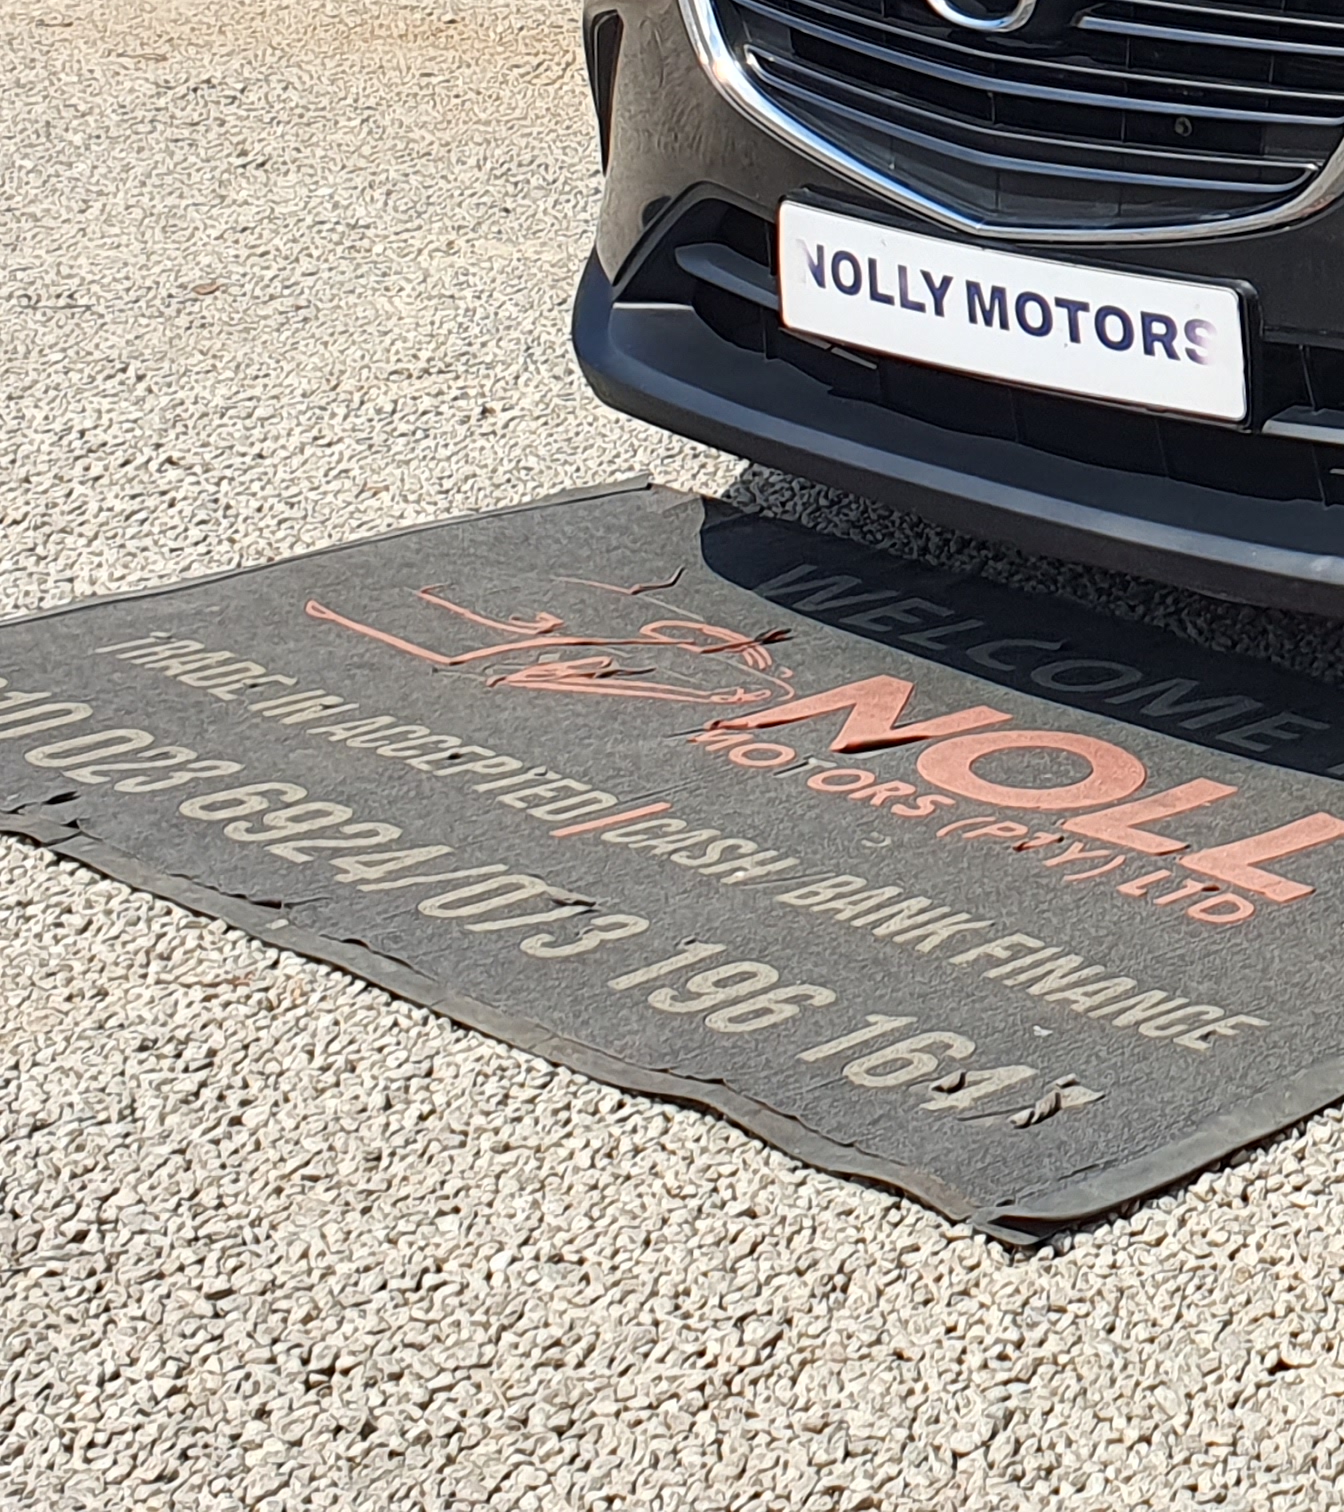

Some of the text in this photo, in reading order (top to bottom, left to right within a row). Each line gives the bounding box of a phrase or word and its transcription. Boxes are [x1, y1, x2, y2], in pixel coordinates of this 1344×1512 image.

[797, 239, 1217, 366] NOLLY MOTORS
[757, 563, 1331, 753] WELCOME
[24, 728, 246, 794] 023
[607, 938, 838, 1034] 196
[94, 631, 298, 701] TRADE
[248, 688, 359, 726] IN
[947, 932, 1271, 1052] FINANCE
[688, 727, 957, 818] MOTORS
[1116, 868, 1256, 925] LTD
